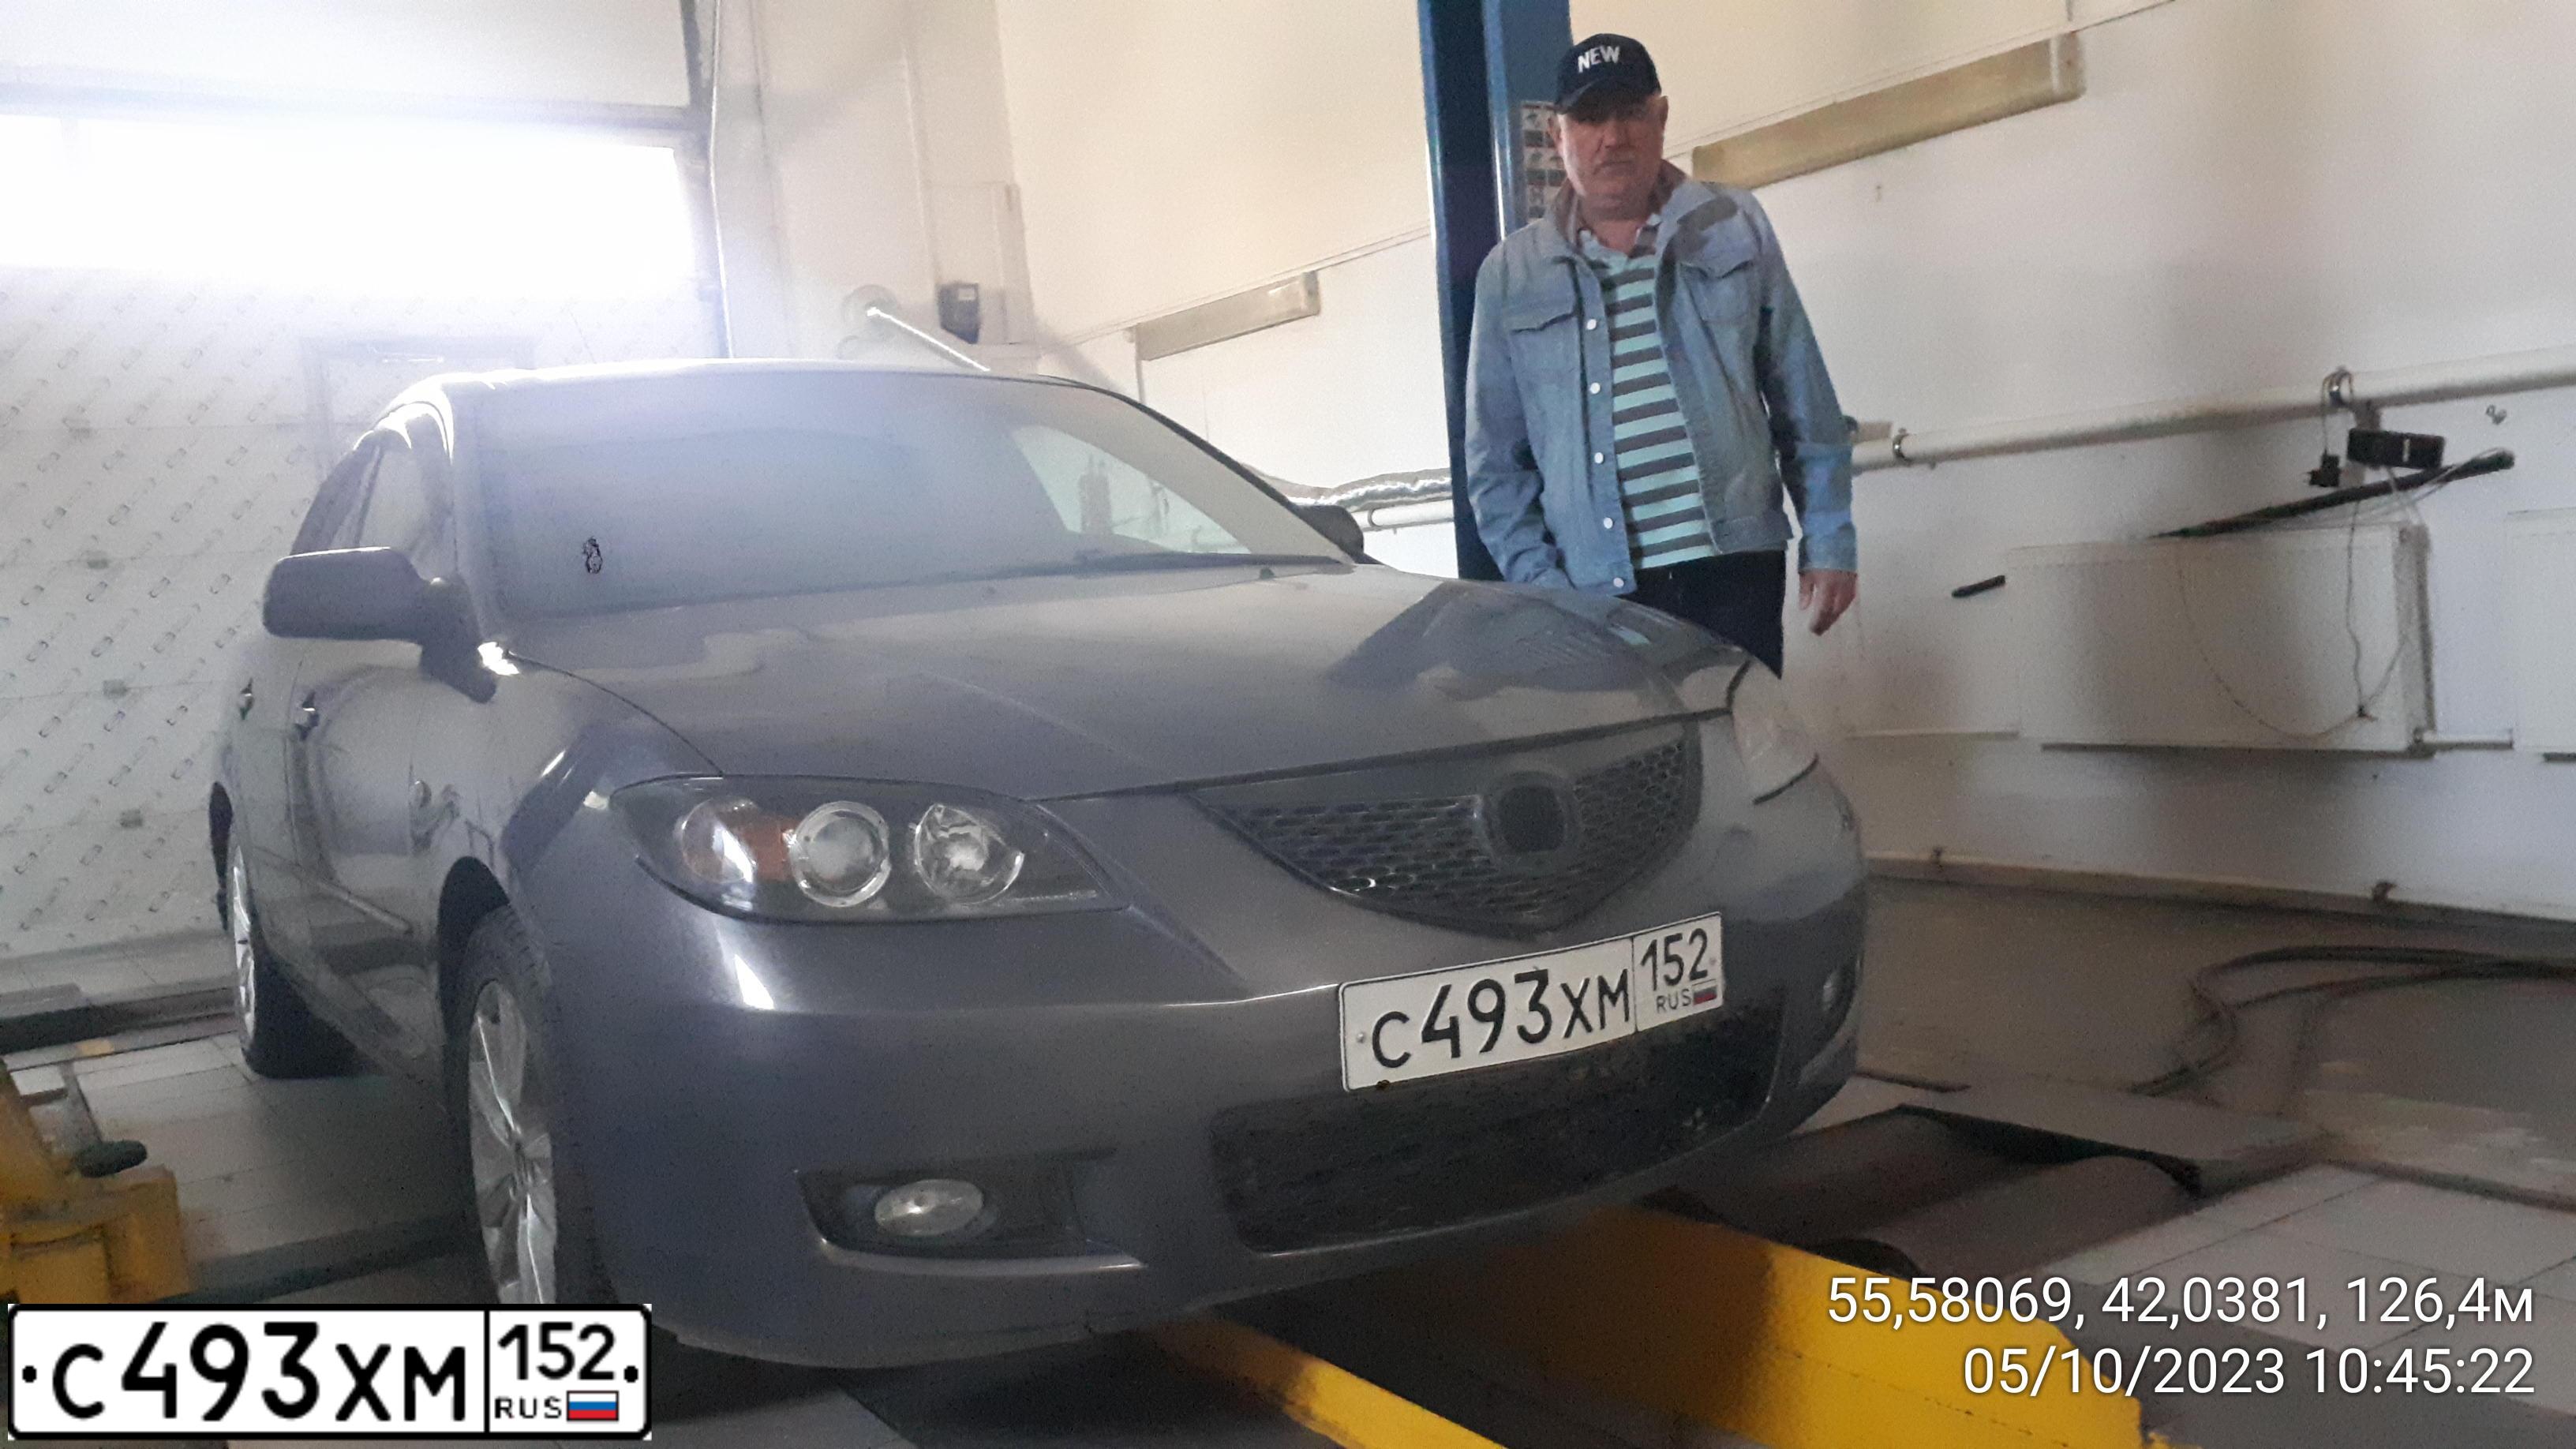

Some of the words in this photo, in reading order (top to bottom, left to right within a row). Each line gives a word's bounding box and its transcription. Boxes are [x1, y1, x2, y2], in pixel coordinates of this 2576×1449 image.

[1578, 45, 1620, 73] NEW
[1641, 927, 1709, 991] 152
[1657, 988, 1691, 1016] RUS
